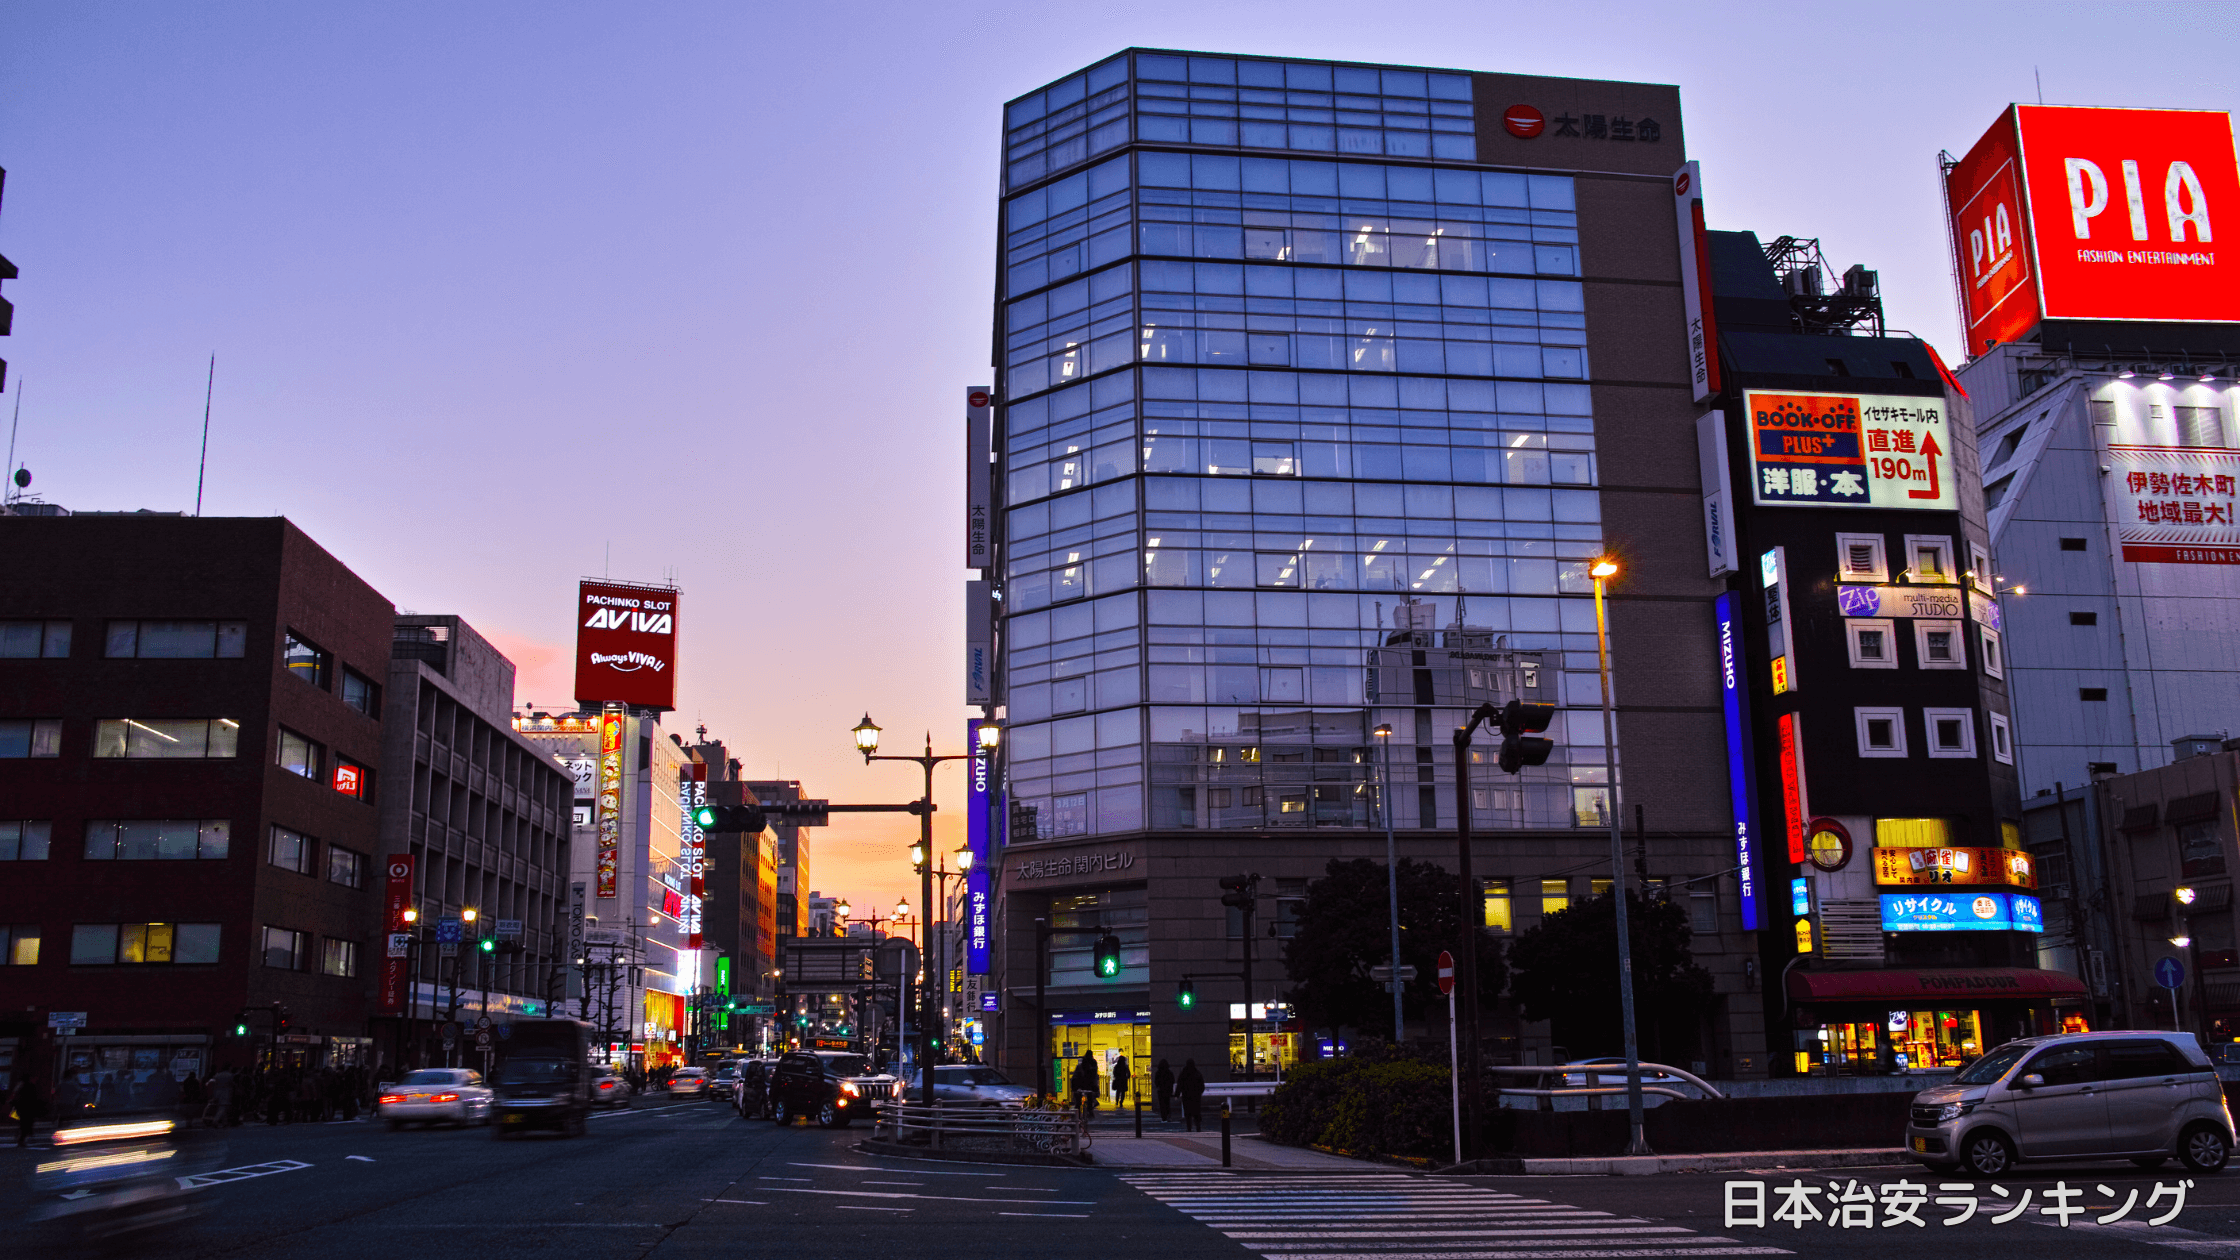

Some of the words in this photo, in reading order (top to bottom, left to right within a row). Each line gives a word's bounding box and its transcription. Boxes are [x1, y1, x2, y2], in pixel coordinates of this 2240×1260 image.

[1554, 112, 1660, 141] 太陽生命
[2064, 157, 2213, 243] PIA
[1970, 202, 2012, 278] PIA
[2077, 249, 2124, 264] FASHION
[2127, 250, 2215, 266] ENTERTAINMENT
[1688, 316, 1706, 384] 太陽生命
[1864, 406, 1939, 424] イセザキモール内
[1867, 428, 1916, 453] 直進
[1870, 457, 1927, 481] 190m
[1762, 467, 1864, 497] 洋服・本
[2126, 471, 2235, 497] 伊勢佐木町
[2137, 499, 2234, 524] 地域最大!
[972, 504, 985, 555] 太陽生命
[1710, 501, 1722, 558] FORVAL
[2176, 550, 2226, 571] FASHION
[587, 595, 640, 608] PACHINKO
[643, 600, 671, 611] SLOT
[1904, 593, 1958, 603] multi-media
[1912, 603, 1958, 616] STUDIO
[591, 652, 628, 664] Always
[628, 651, 666, 672] VIVA!!
[1721, 620, 1735, 690] MIZUHO
[566, 761, 592, 771] ネット
[692, 848, 703, 880] SLOT
[1016, 857, 1072, 881] 太陽生命
[1075, 851, 1134, 874] 関内ビル
[1737, 822, 1752, 898] みずほ銀行
[1925, 849, 1954, 866] 麻雀
[1929, 870, 1952, 883] リオ
[1893, 896, 1957, 916] リサイクル
[572, 903, 582, 937] TOKYO
[973, 891, 986, 949] みずほ銀行
[571, 939, 582, 960] GAS
[967, 975, 977, 1012] 友銀行
[1918, 976, 2021, 989] POMPADOUR
[480, 1019, 489, 1027] 50
